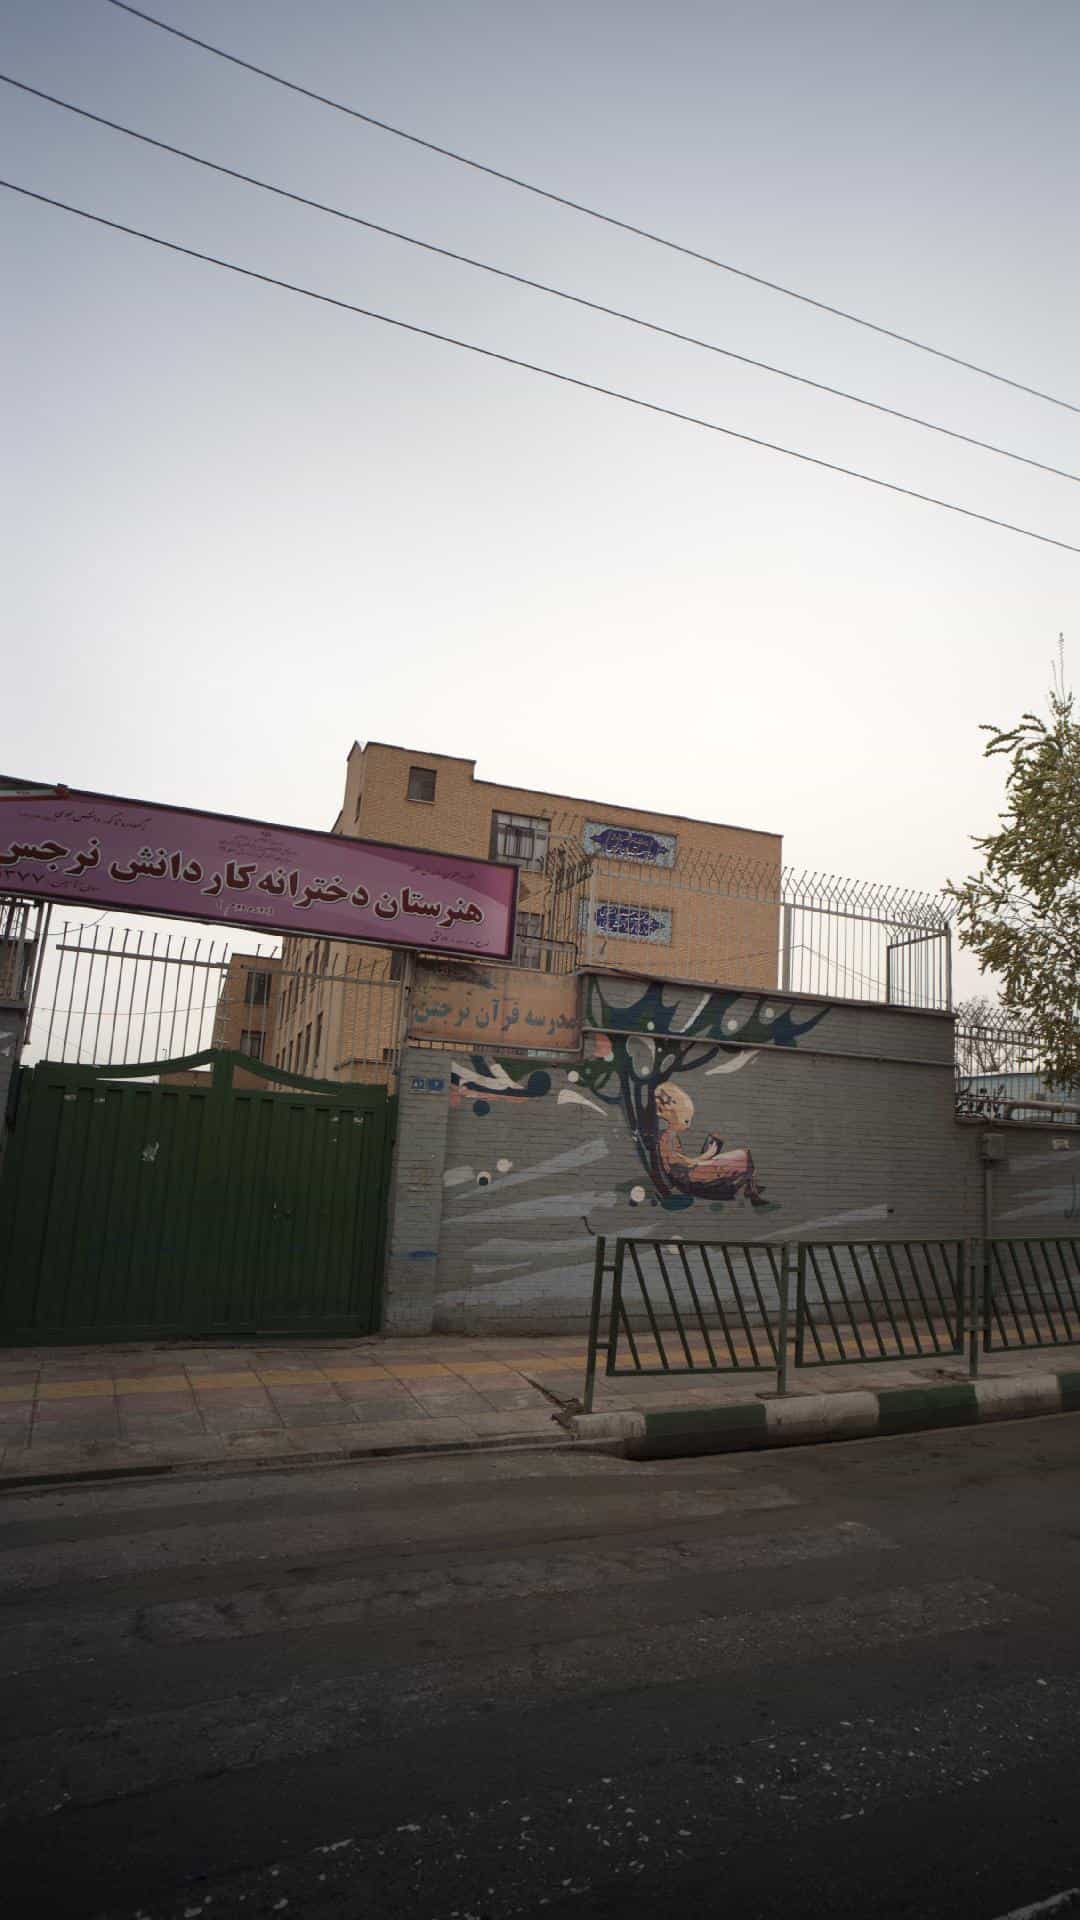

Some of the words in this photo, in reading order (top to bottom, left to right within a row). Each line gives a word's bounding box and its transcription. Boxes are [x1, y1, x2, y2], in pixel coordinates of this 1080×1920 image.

[0, 837, 100, 877] نرجس
[257, 867, 369, 908] دخترانه
[374, 886, 484, 928] هنرستان
[475, 997, 520, 1031] قرآن
